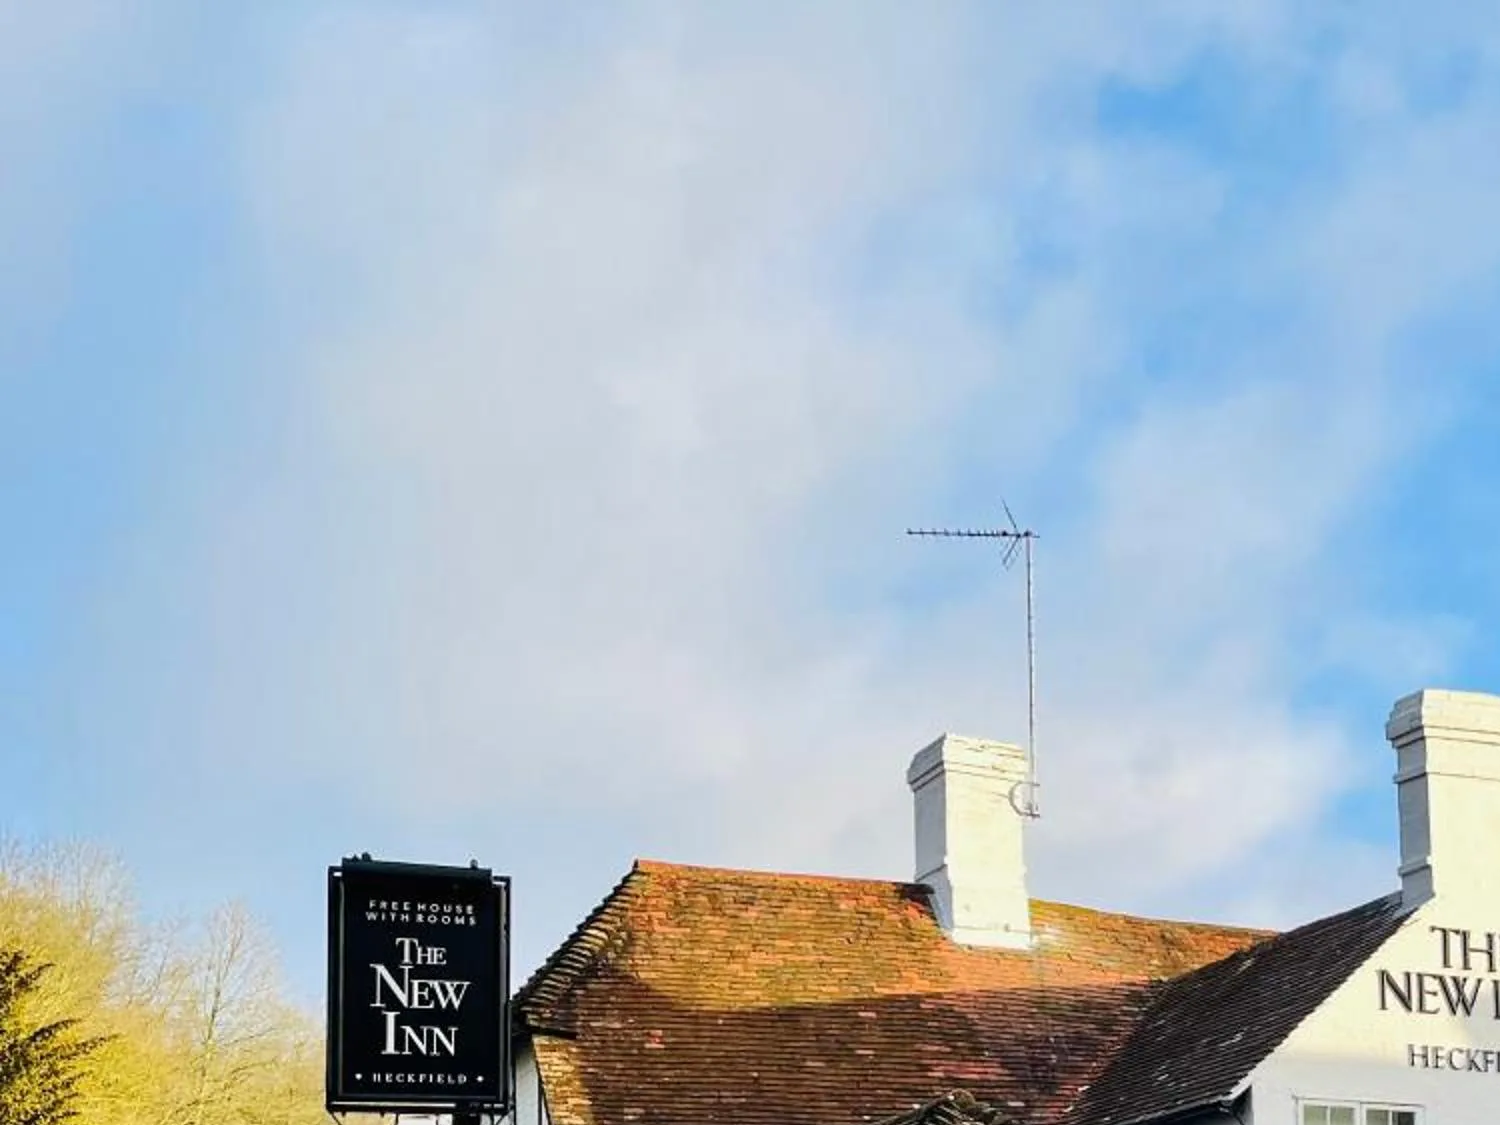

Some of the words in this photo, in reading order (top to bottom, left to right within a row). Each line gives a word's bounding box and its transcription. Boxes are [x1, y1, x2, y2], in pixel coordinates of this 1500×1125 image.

[365, 911, 409, 923] WITH
[416, 913, 477, 926] ROOMS
[369, 900, 412, 911] FREE
[417, 903, 474, 915] HOUSE
[395, 937, 447, 965] THE
[369, 963, 472, 1011] NEW
[1376, 969, 1483, 1017] NEW
[381, 1010, 459, 1057] INN
[372, 1072, 468, 1085] HECKFIELD
